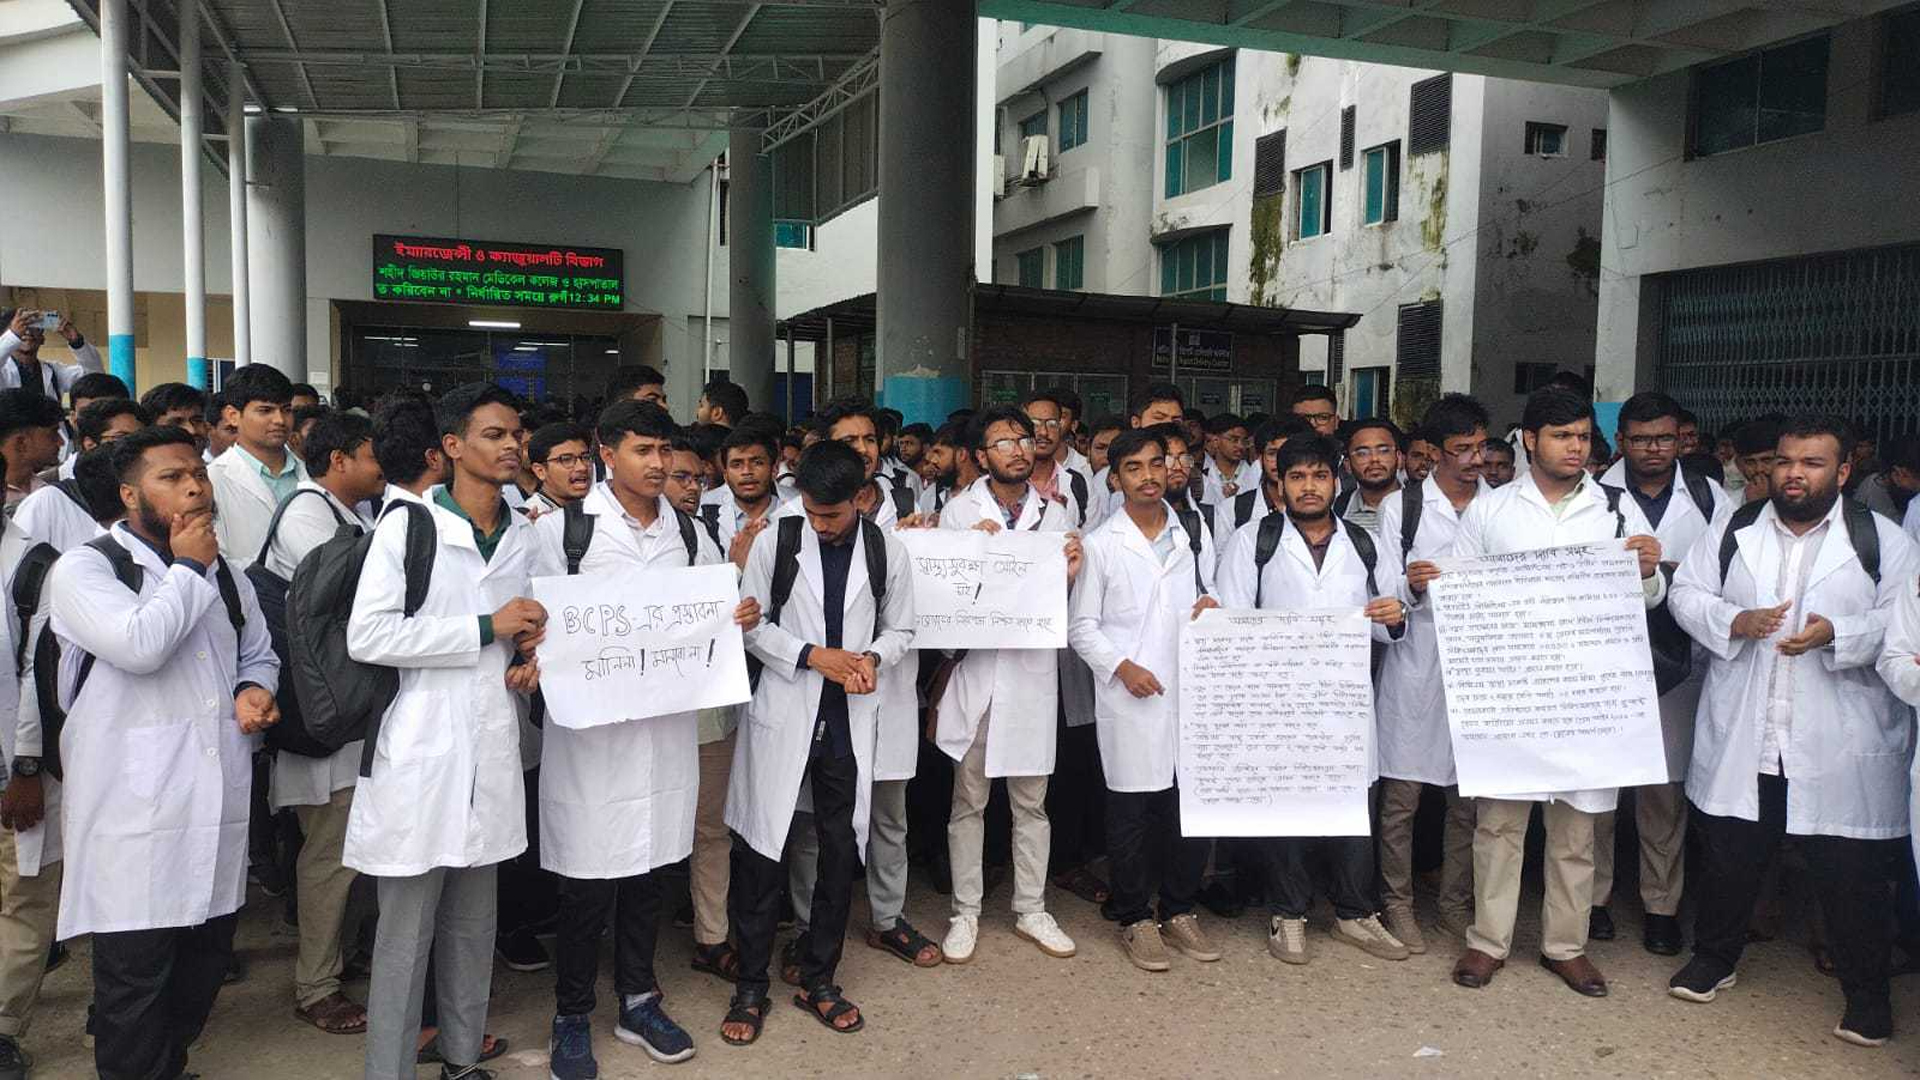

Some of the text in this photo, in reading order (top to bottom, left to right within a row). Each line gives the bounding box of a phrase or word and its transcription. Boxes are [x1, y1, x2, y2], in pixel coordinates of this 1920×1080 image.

[475, 250, 485, 261] ও
[565, 252, 604, 268] বিভাগ
[376, 263, 404, 279] শহীদ
[408, 264, 445, 281] জিয়াউর
[447, 271, 480, 284] রহমান
[483, 269, 525, 286] মেডিকেল
[530, 275, 558, 287] কলেজ
[573, 277, 619, 290] হাসপাতাল
[570, 291, 620, 304] 12:34 PM
[1534, 546, 1560, 561] দাবি
